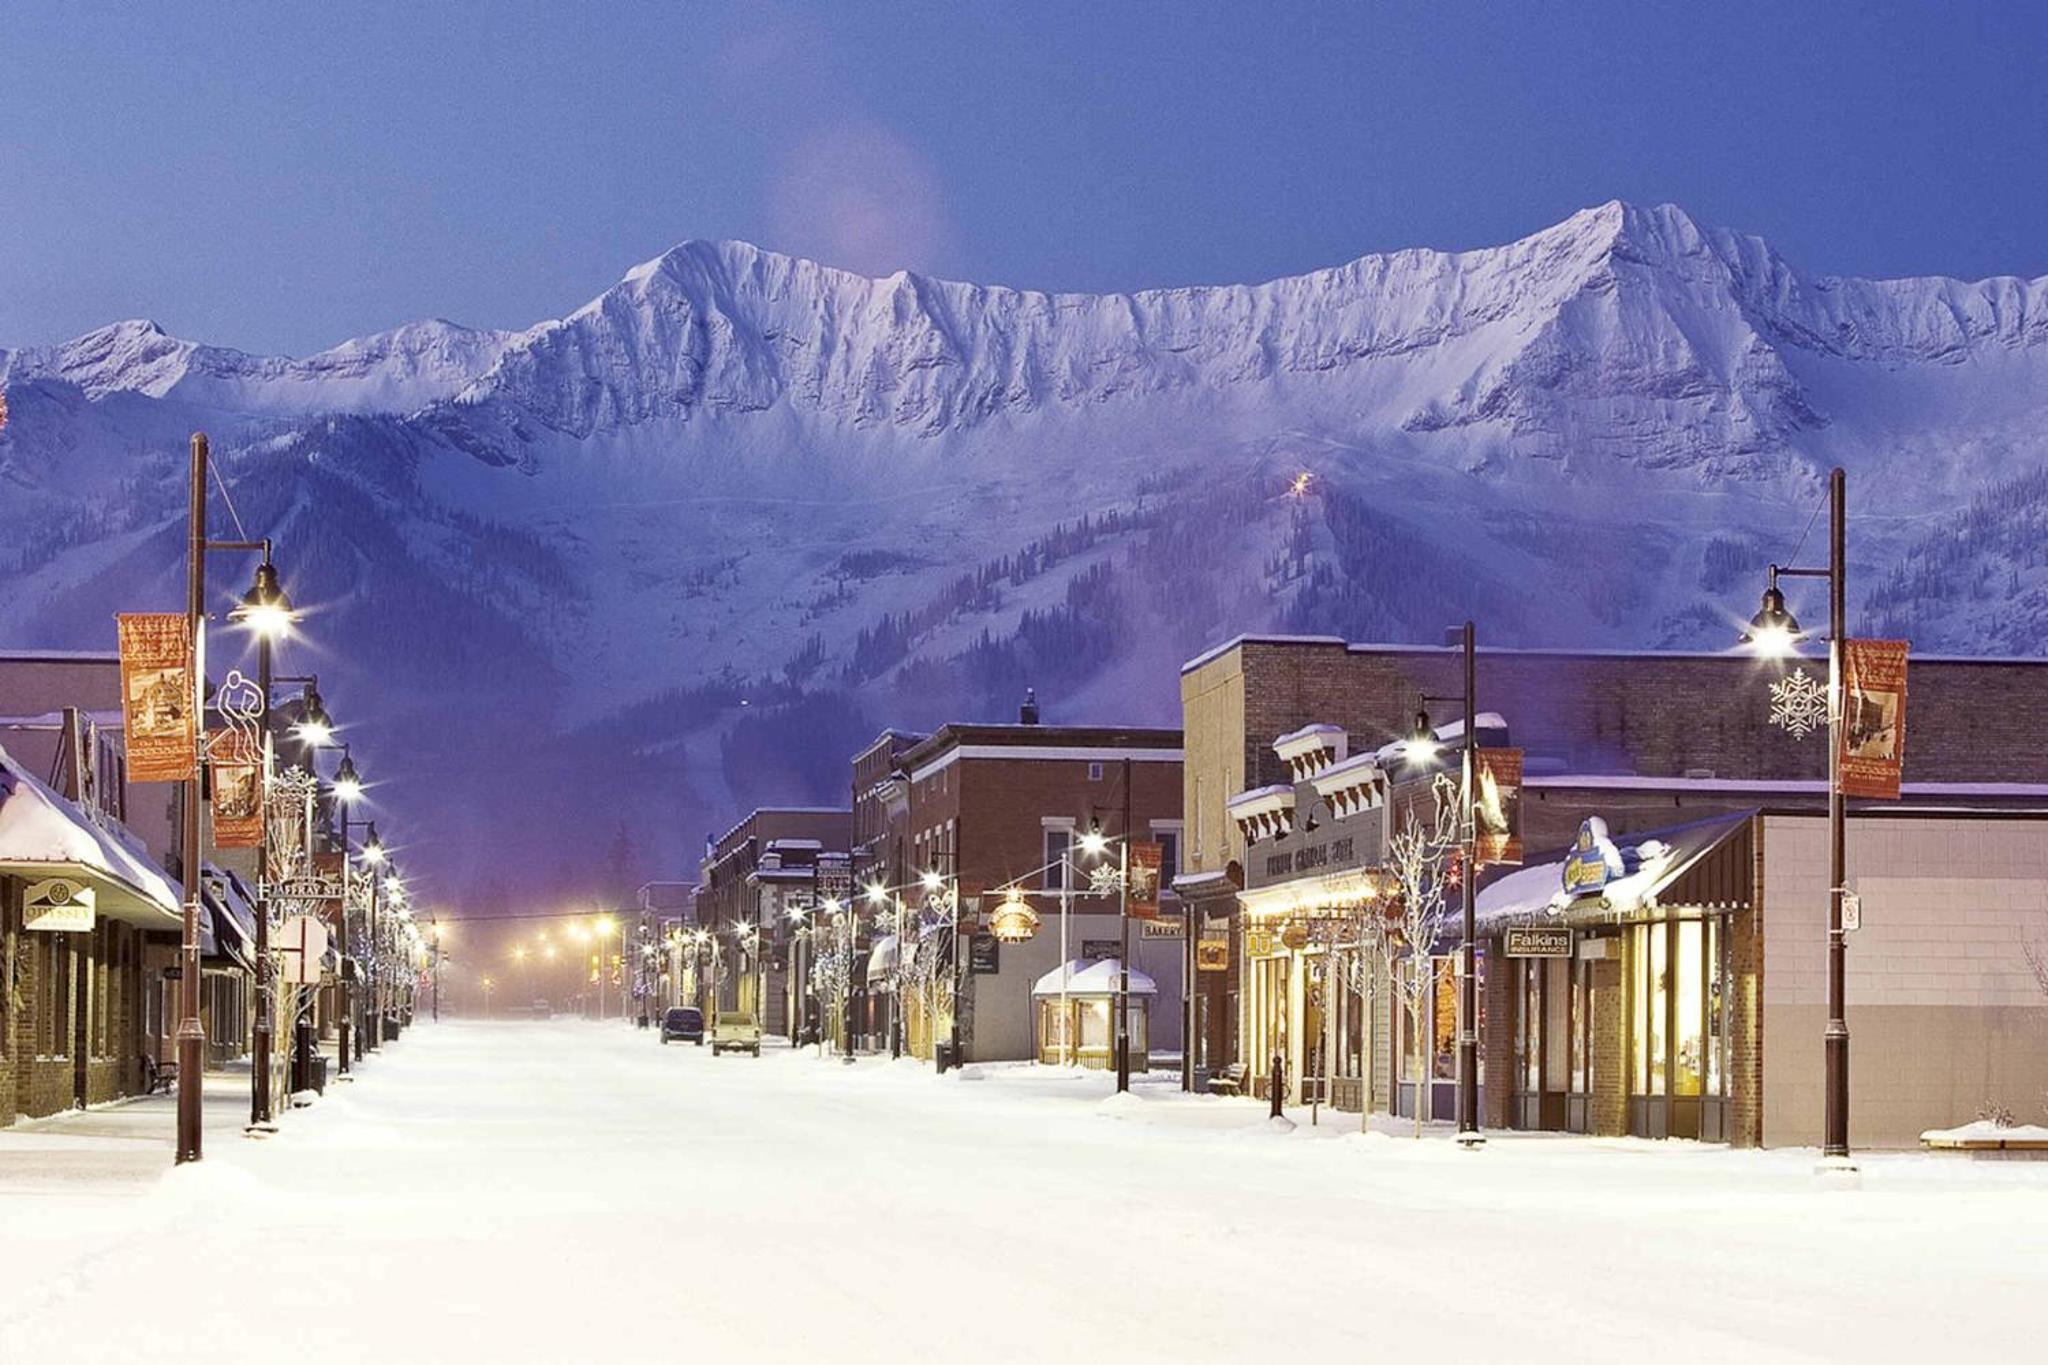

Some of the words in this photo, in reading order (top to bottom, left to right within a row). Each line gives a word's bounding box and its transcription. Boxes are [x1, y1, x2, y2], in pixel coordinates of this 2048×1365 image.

[272, 883, 320, 896] JAFFRAY
[1145, 926, 1182, 937] BAKERY
[1510, 932, 1568, 946] Falkins
